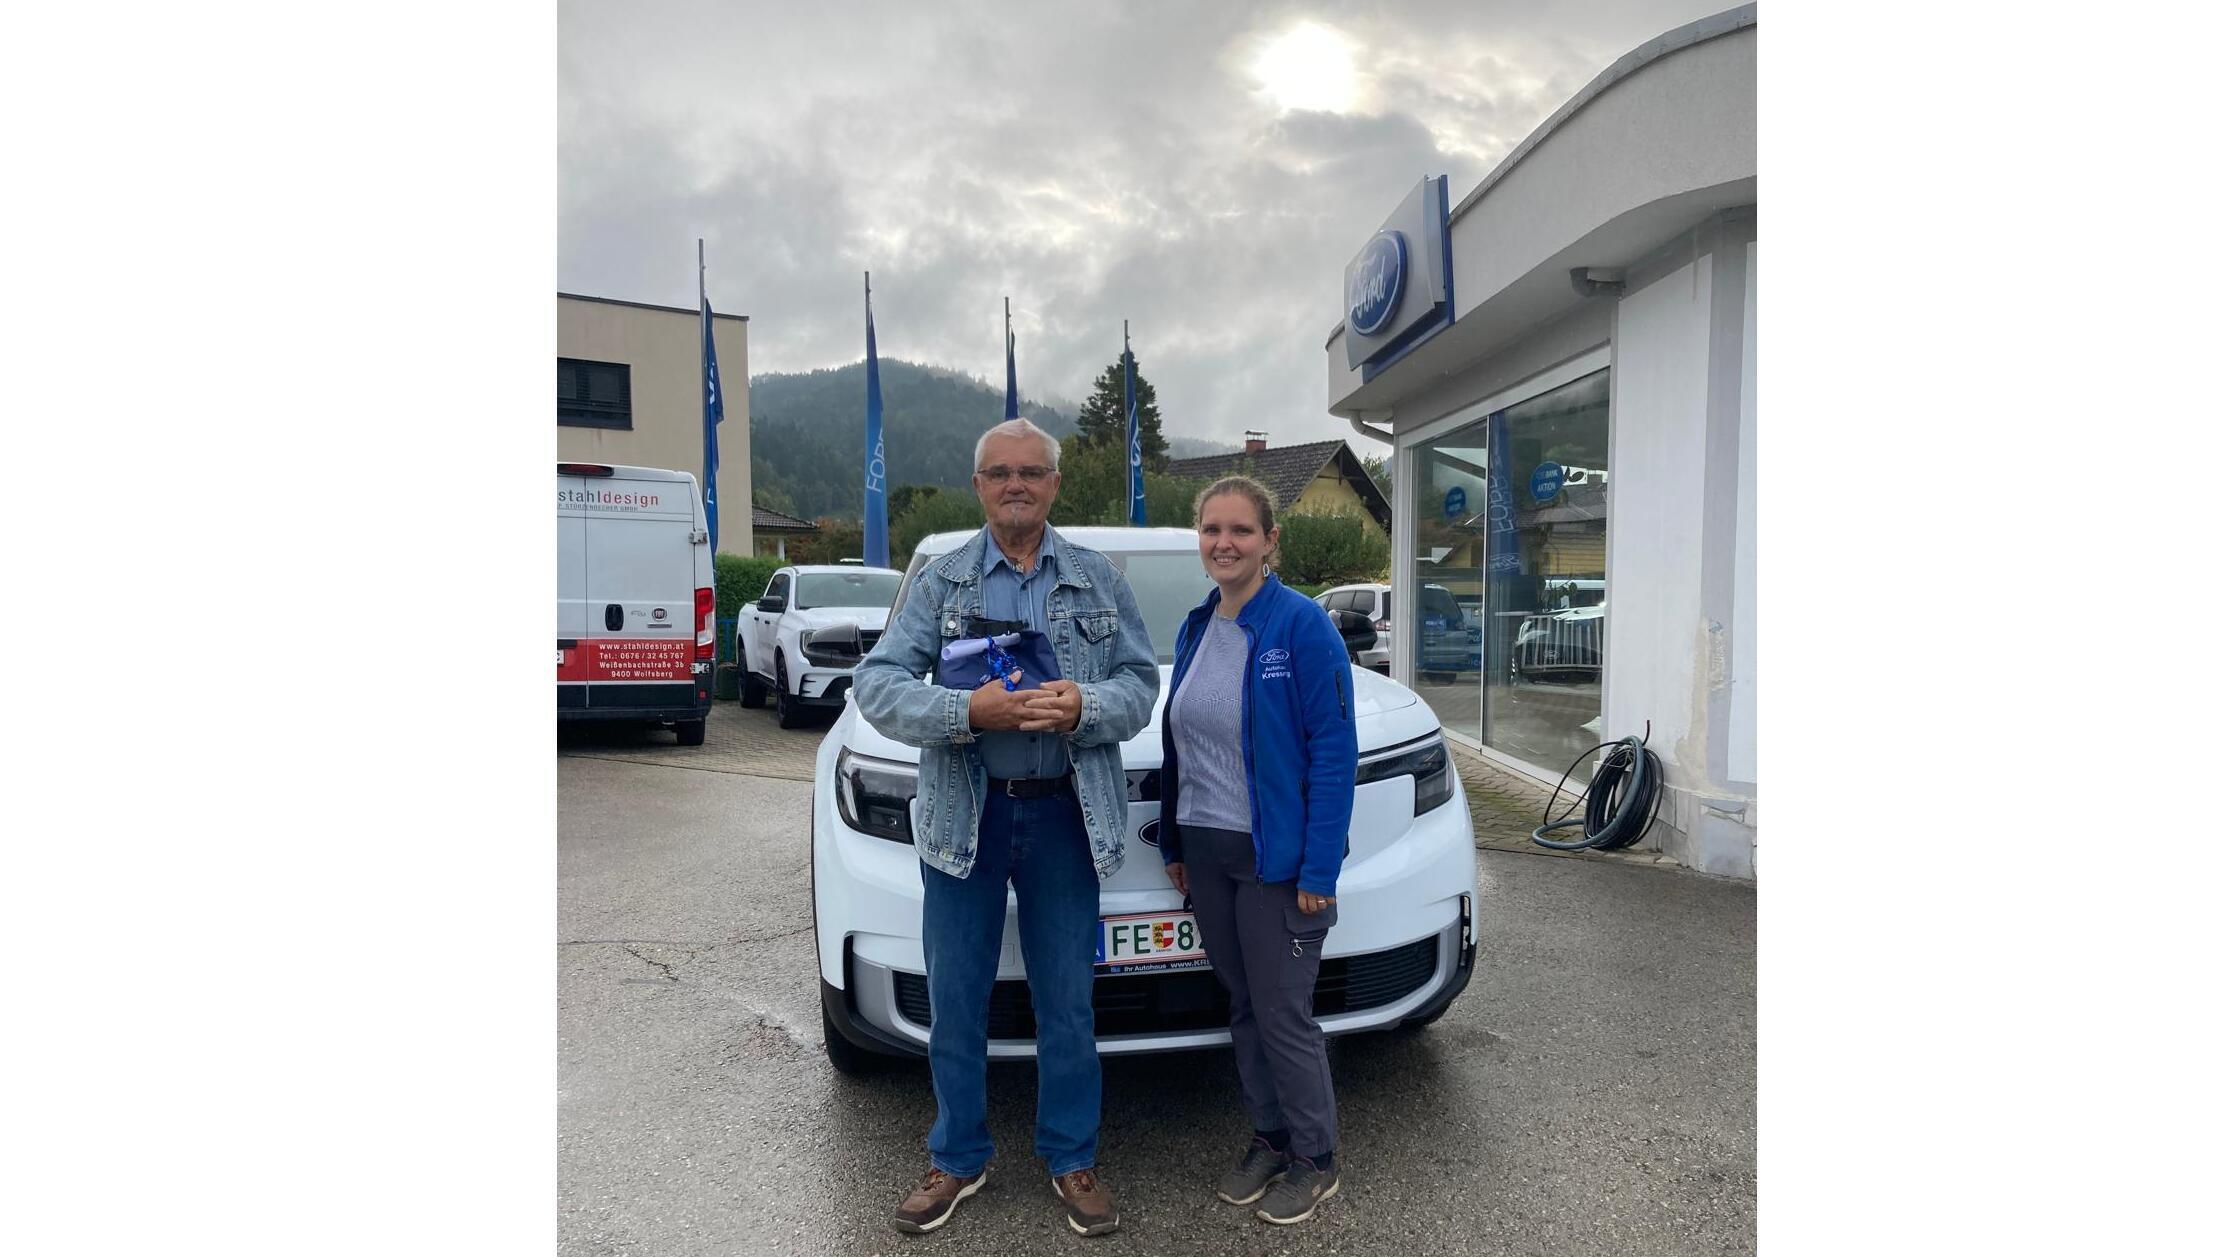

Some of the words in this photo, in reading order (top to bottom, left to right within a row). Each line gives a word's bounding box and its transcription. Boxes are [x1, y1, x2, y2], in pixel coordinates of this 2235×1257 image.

[1352, 253, 1386, 319] Ford
[558, 489, 659, 508] stahldesign
[599, 643, 684, 651] www.stahldesign.at
[599, 661, 671, 669] Weißenbachstraße
[633, 670, 673, 678] Wolfsberg
[1111, 924, 1151, 956] FE
[1134, 963, 1167, 972] Autohaus
